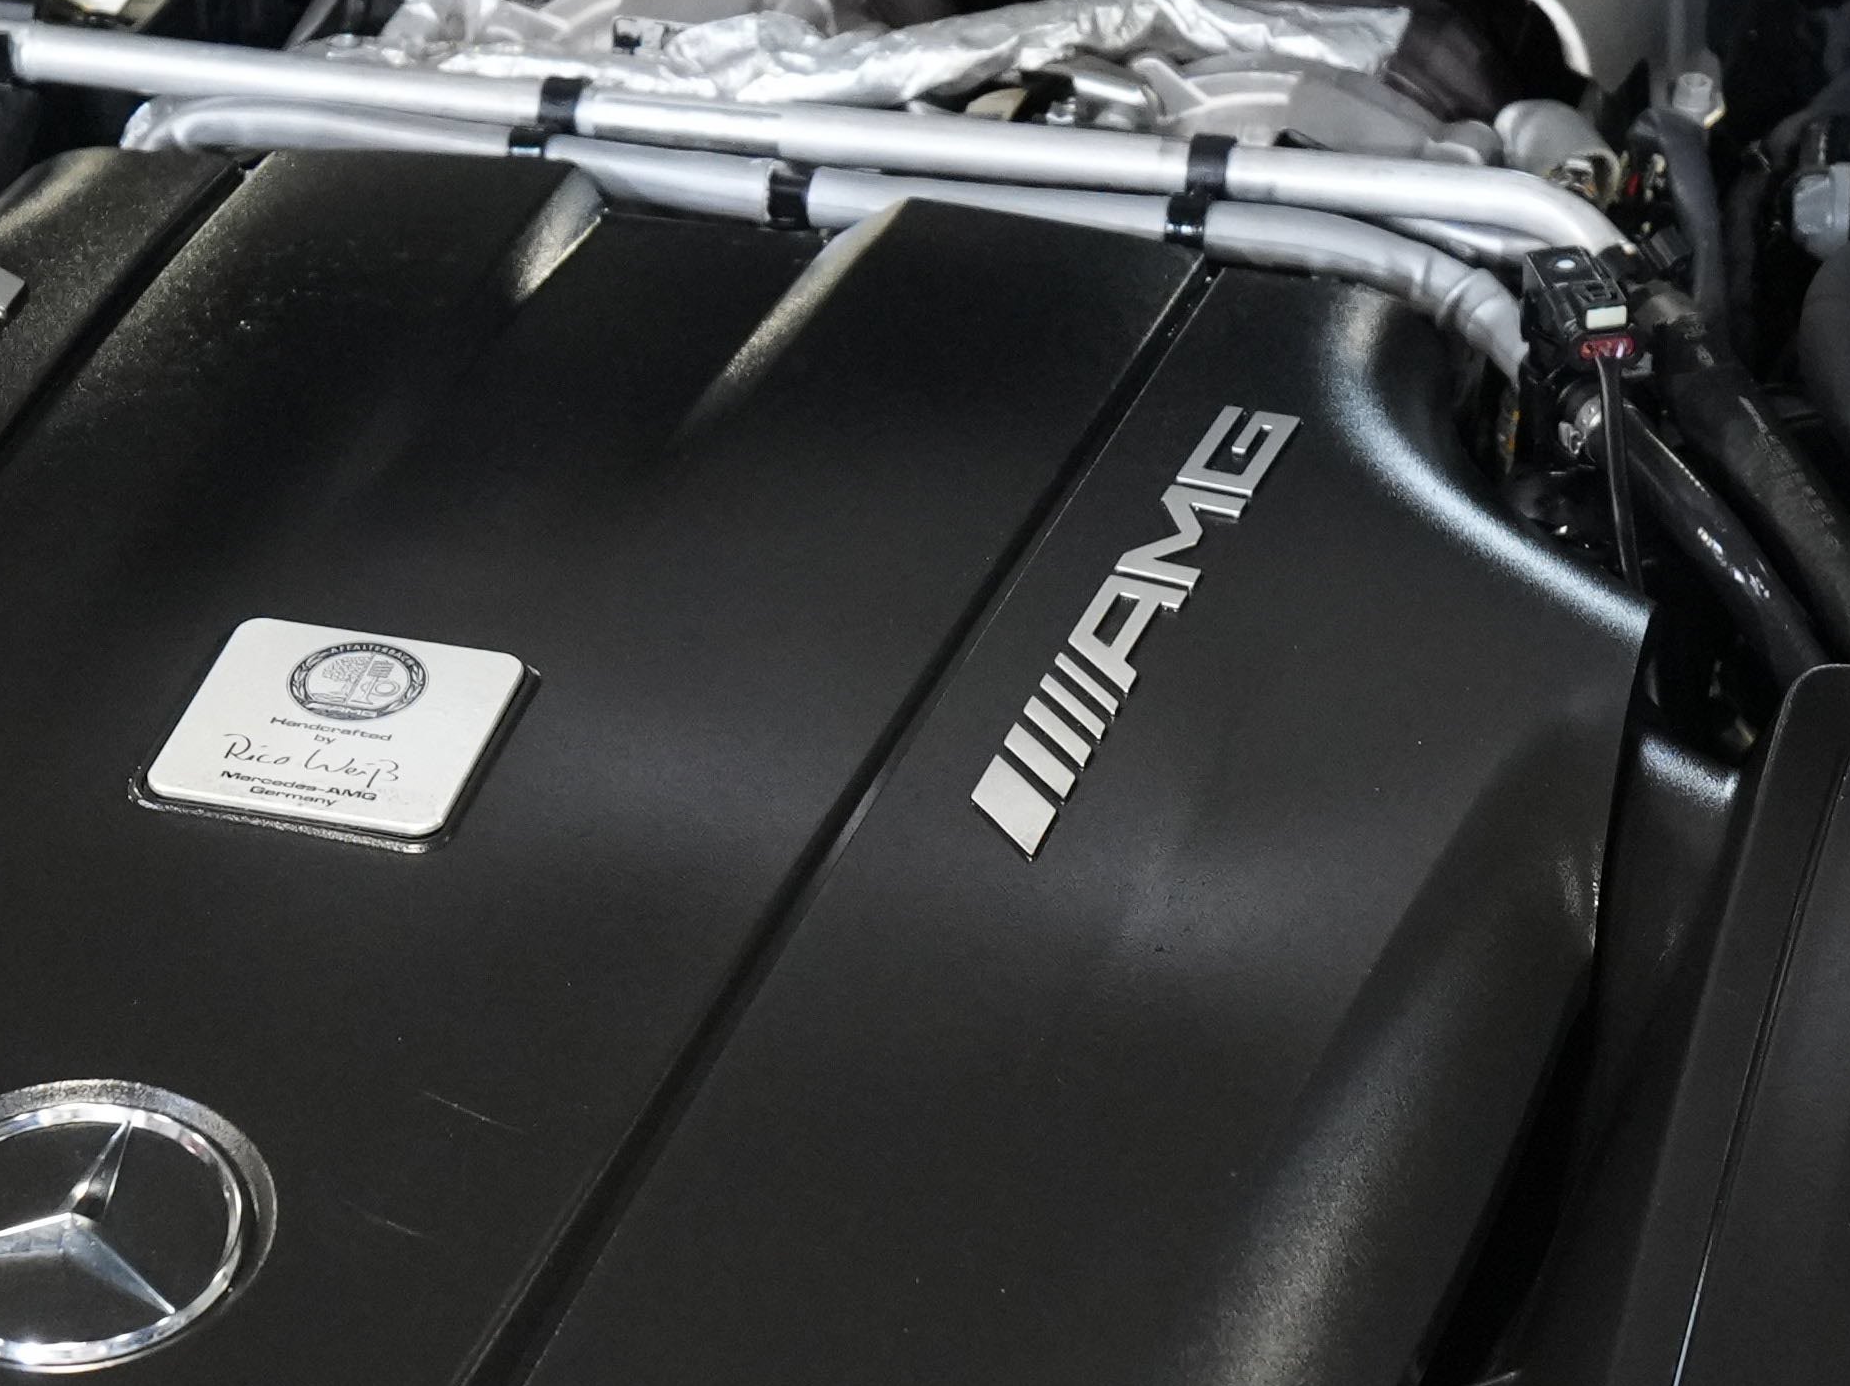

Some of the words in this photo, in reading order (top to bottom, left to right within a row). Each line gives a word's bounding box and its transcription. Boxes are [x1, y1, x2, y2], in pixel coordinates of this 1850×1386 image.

[1067, 404, 1302, 694] AMG
[270, 716, 393, 742] Handcrafted
[313, 733, 337, 745] by
[222, 733, 291, 765] Rico
[220, 769, 378, 801] Mercedes-AMG
[249, 785, 338, 808] Germany
